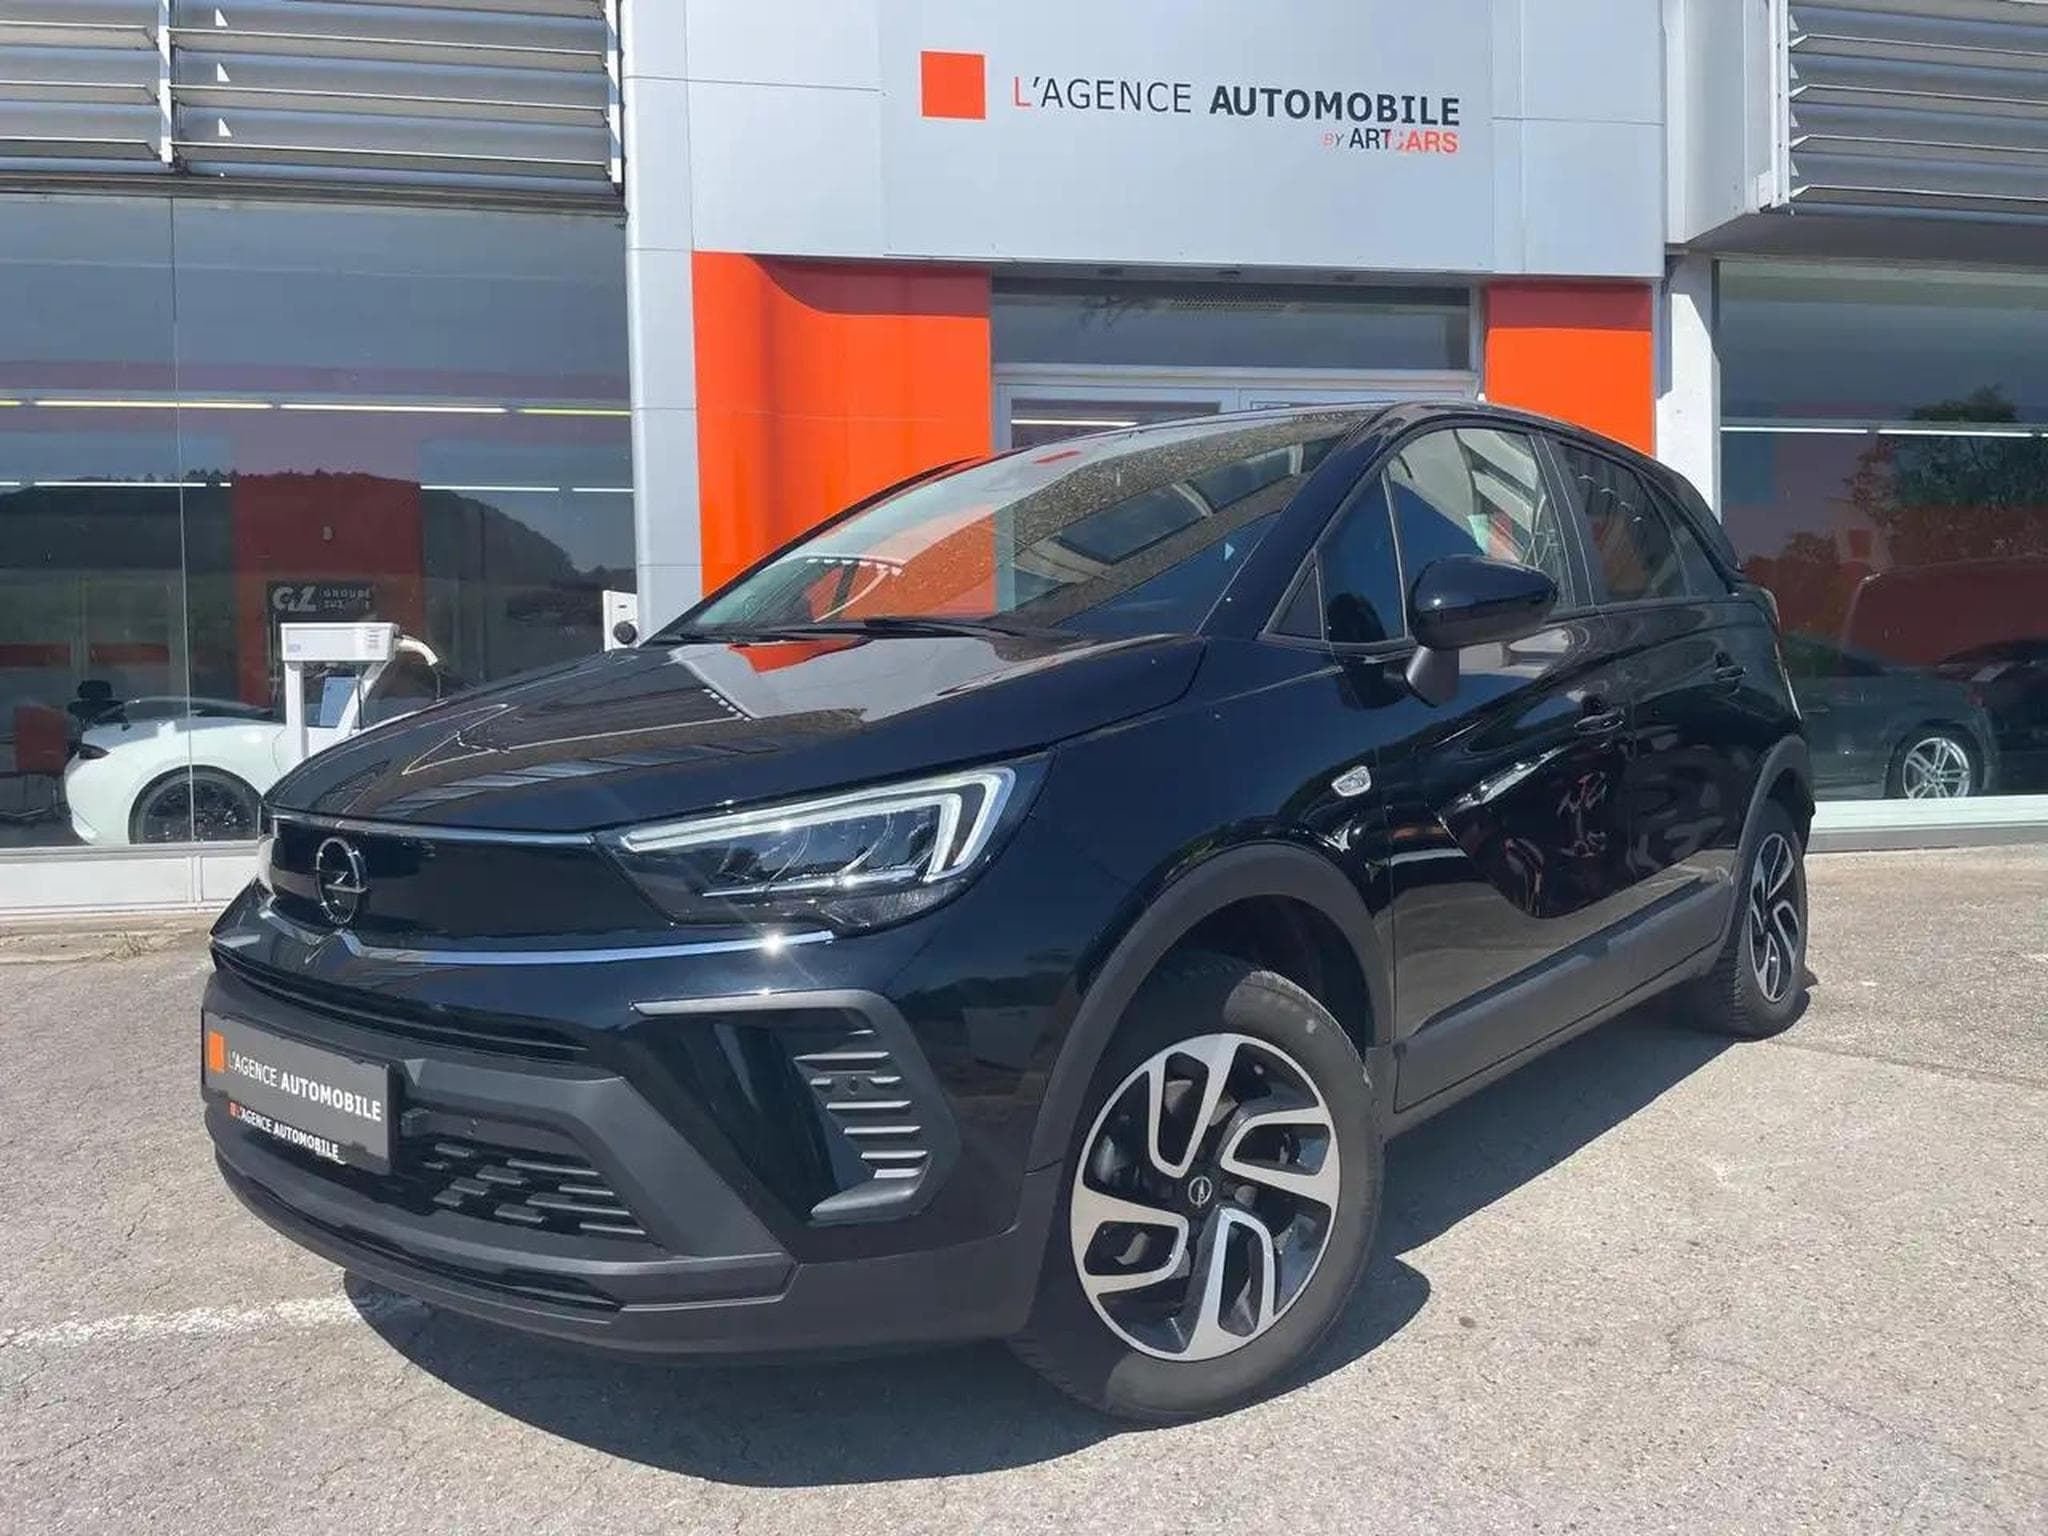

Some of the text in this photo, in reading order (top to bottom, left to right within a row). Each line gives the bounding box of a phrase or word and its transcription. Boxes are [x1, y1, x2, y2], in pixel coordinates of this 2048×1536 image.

[1013, 76, 1460, 126] L'AGENCE AUTOMOBILE
[229, 1051, 382, 1122] L'AGENCE AUTOMOBILE
[273, 1121, 339, 1154] AUTOMOBILE
